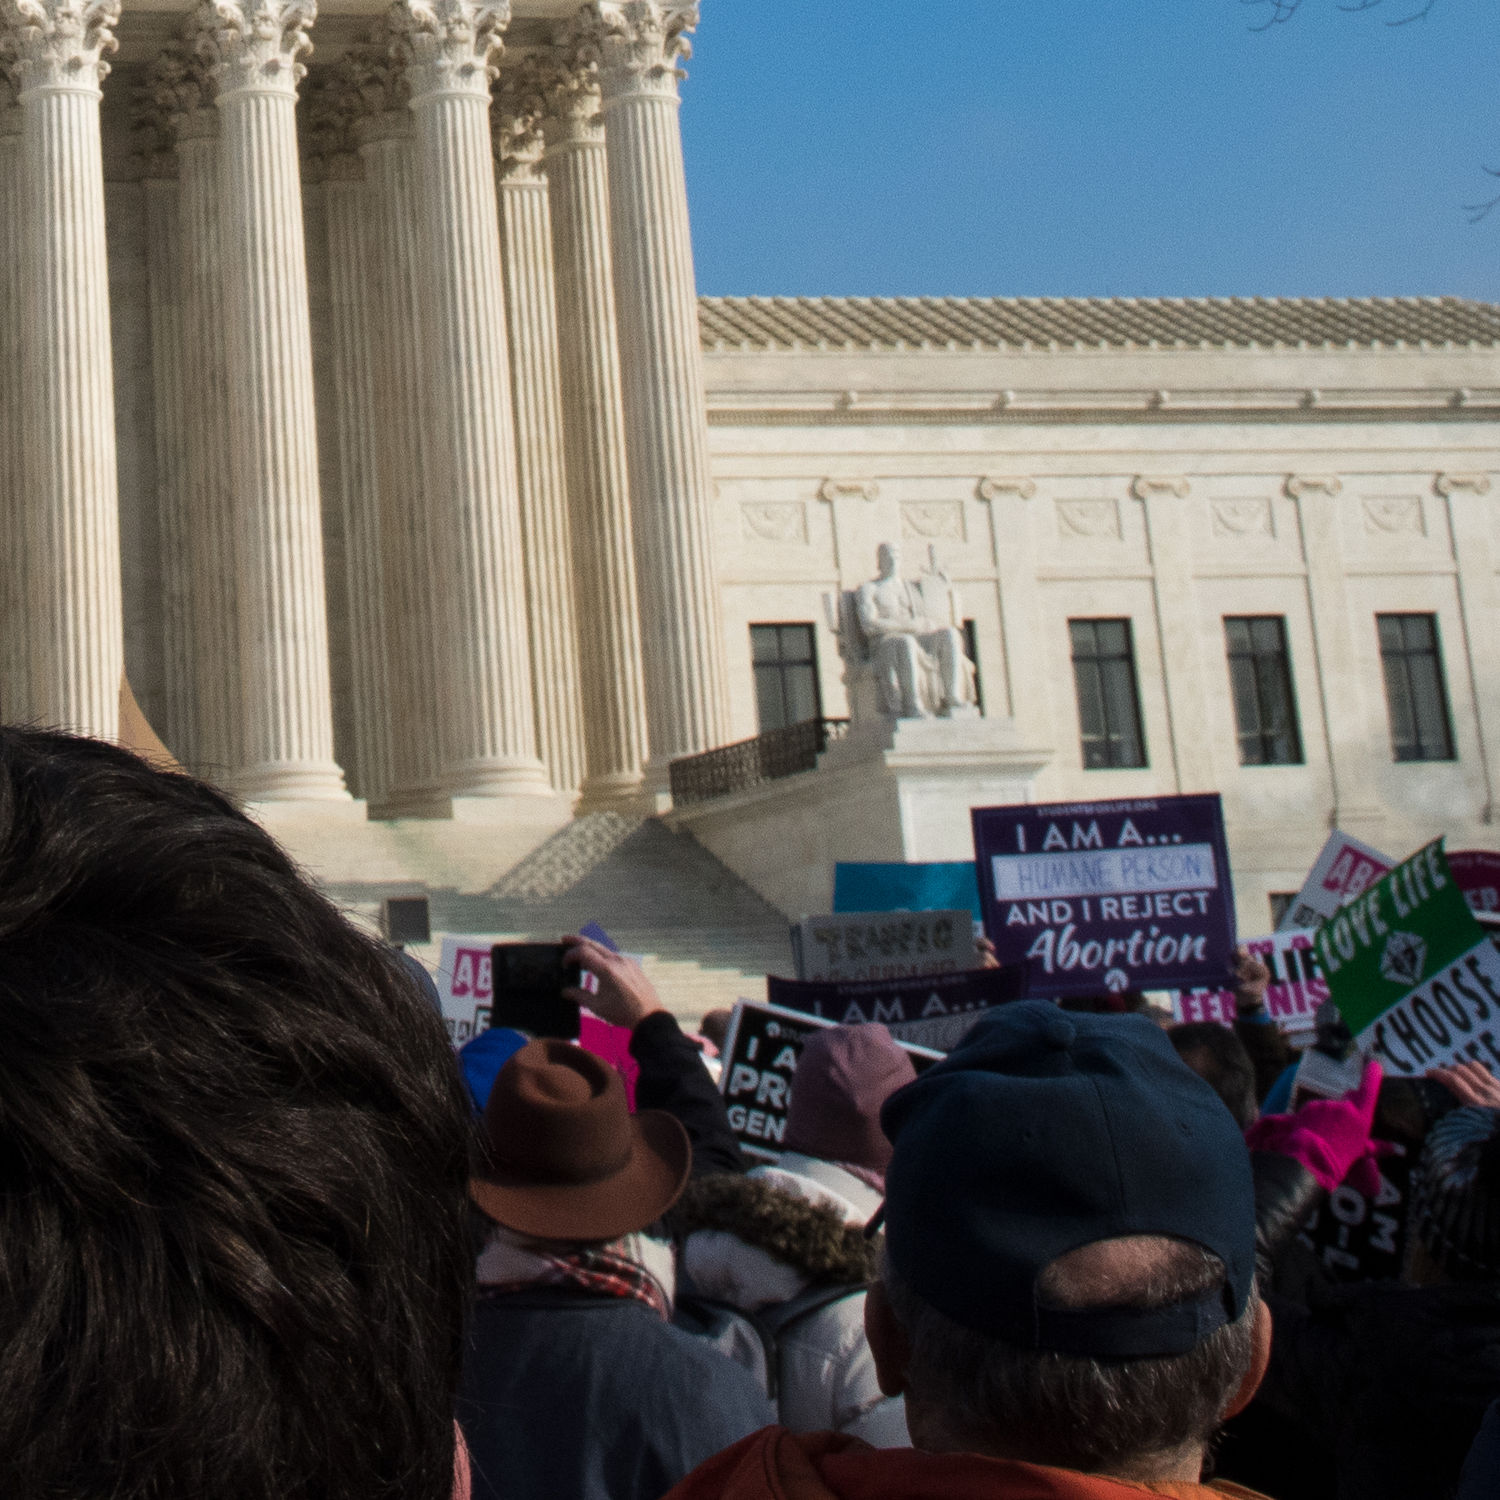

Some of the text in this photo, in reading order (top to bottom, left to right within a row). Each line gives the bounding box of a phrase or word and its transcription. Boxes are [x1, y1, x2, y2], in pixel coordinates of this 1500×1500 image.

[1016, 823, 1028, 853] I
[1042, 819, 1104, 851] AM
[1006, 891, 1210, 927] AND I REJECT
[1319, 842, 1448, 975] LOVE LIFE
[1026, 922, 1207, 974] Abortion
[843, 996, 905, 1024] AM
[746, 1035, 760, 1062] I
[727, 1061, 792, 1111] PR
